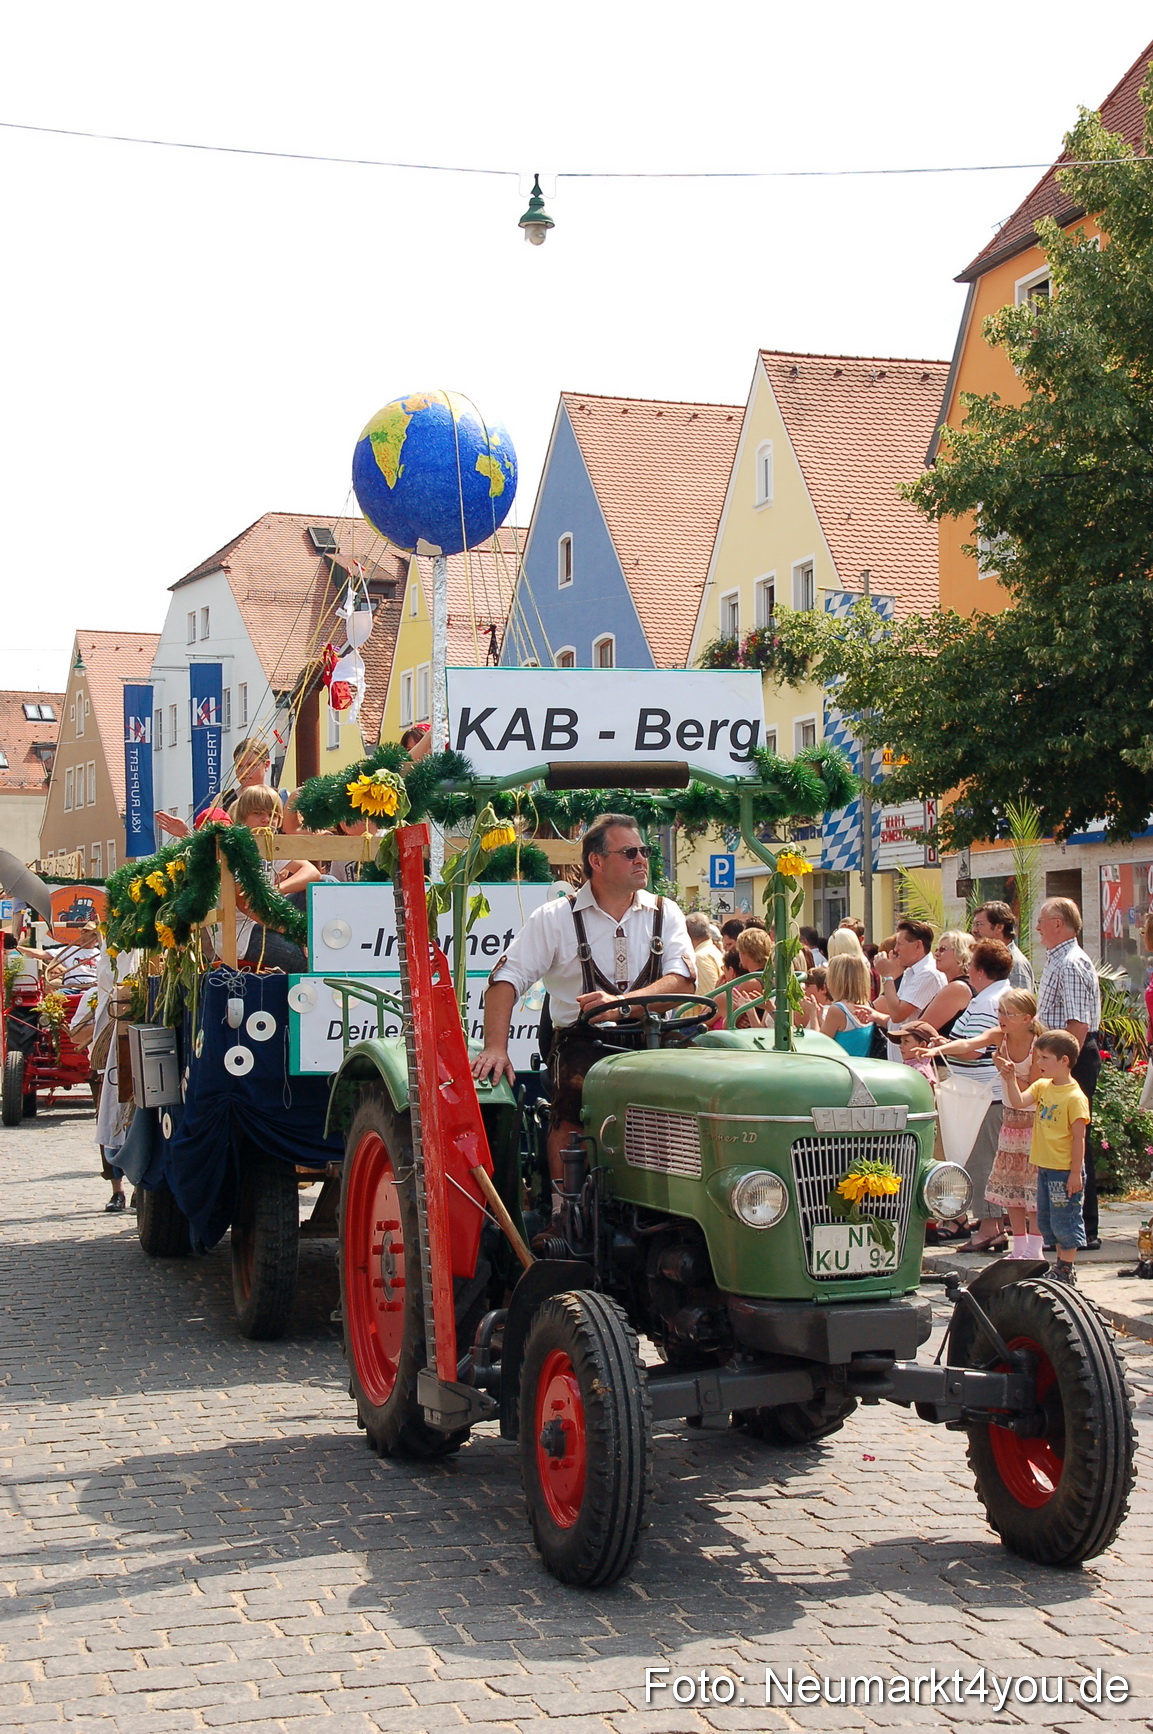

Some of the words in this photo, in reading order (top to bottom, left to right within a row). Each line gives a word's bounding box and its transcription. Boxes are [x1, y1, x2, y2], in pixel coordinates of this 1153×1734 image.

[456, 707, 579, 751] KAB
[635, 707, 761, 763] Berg
[206, 731, 218, 795] RUPPERT
[927, 801, 936, 862] KIO
[715, 858, 730, 885] P
[814, 1107, 907, 1131] FENDT
[816, 1249, 850, 1271] KU
[870, 1247, 895, 1269] 92
